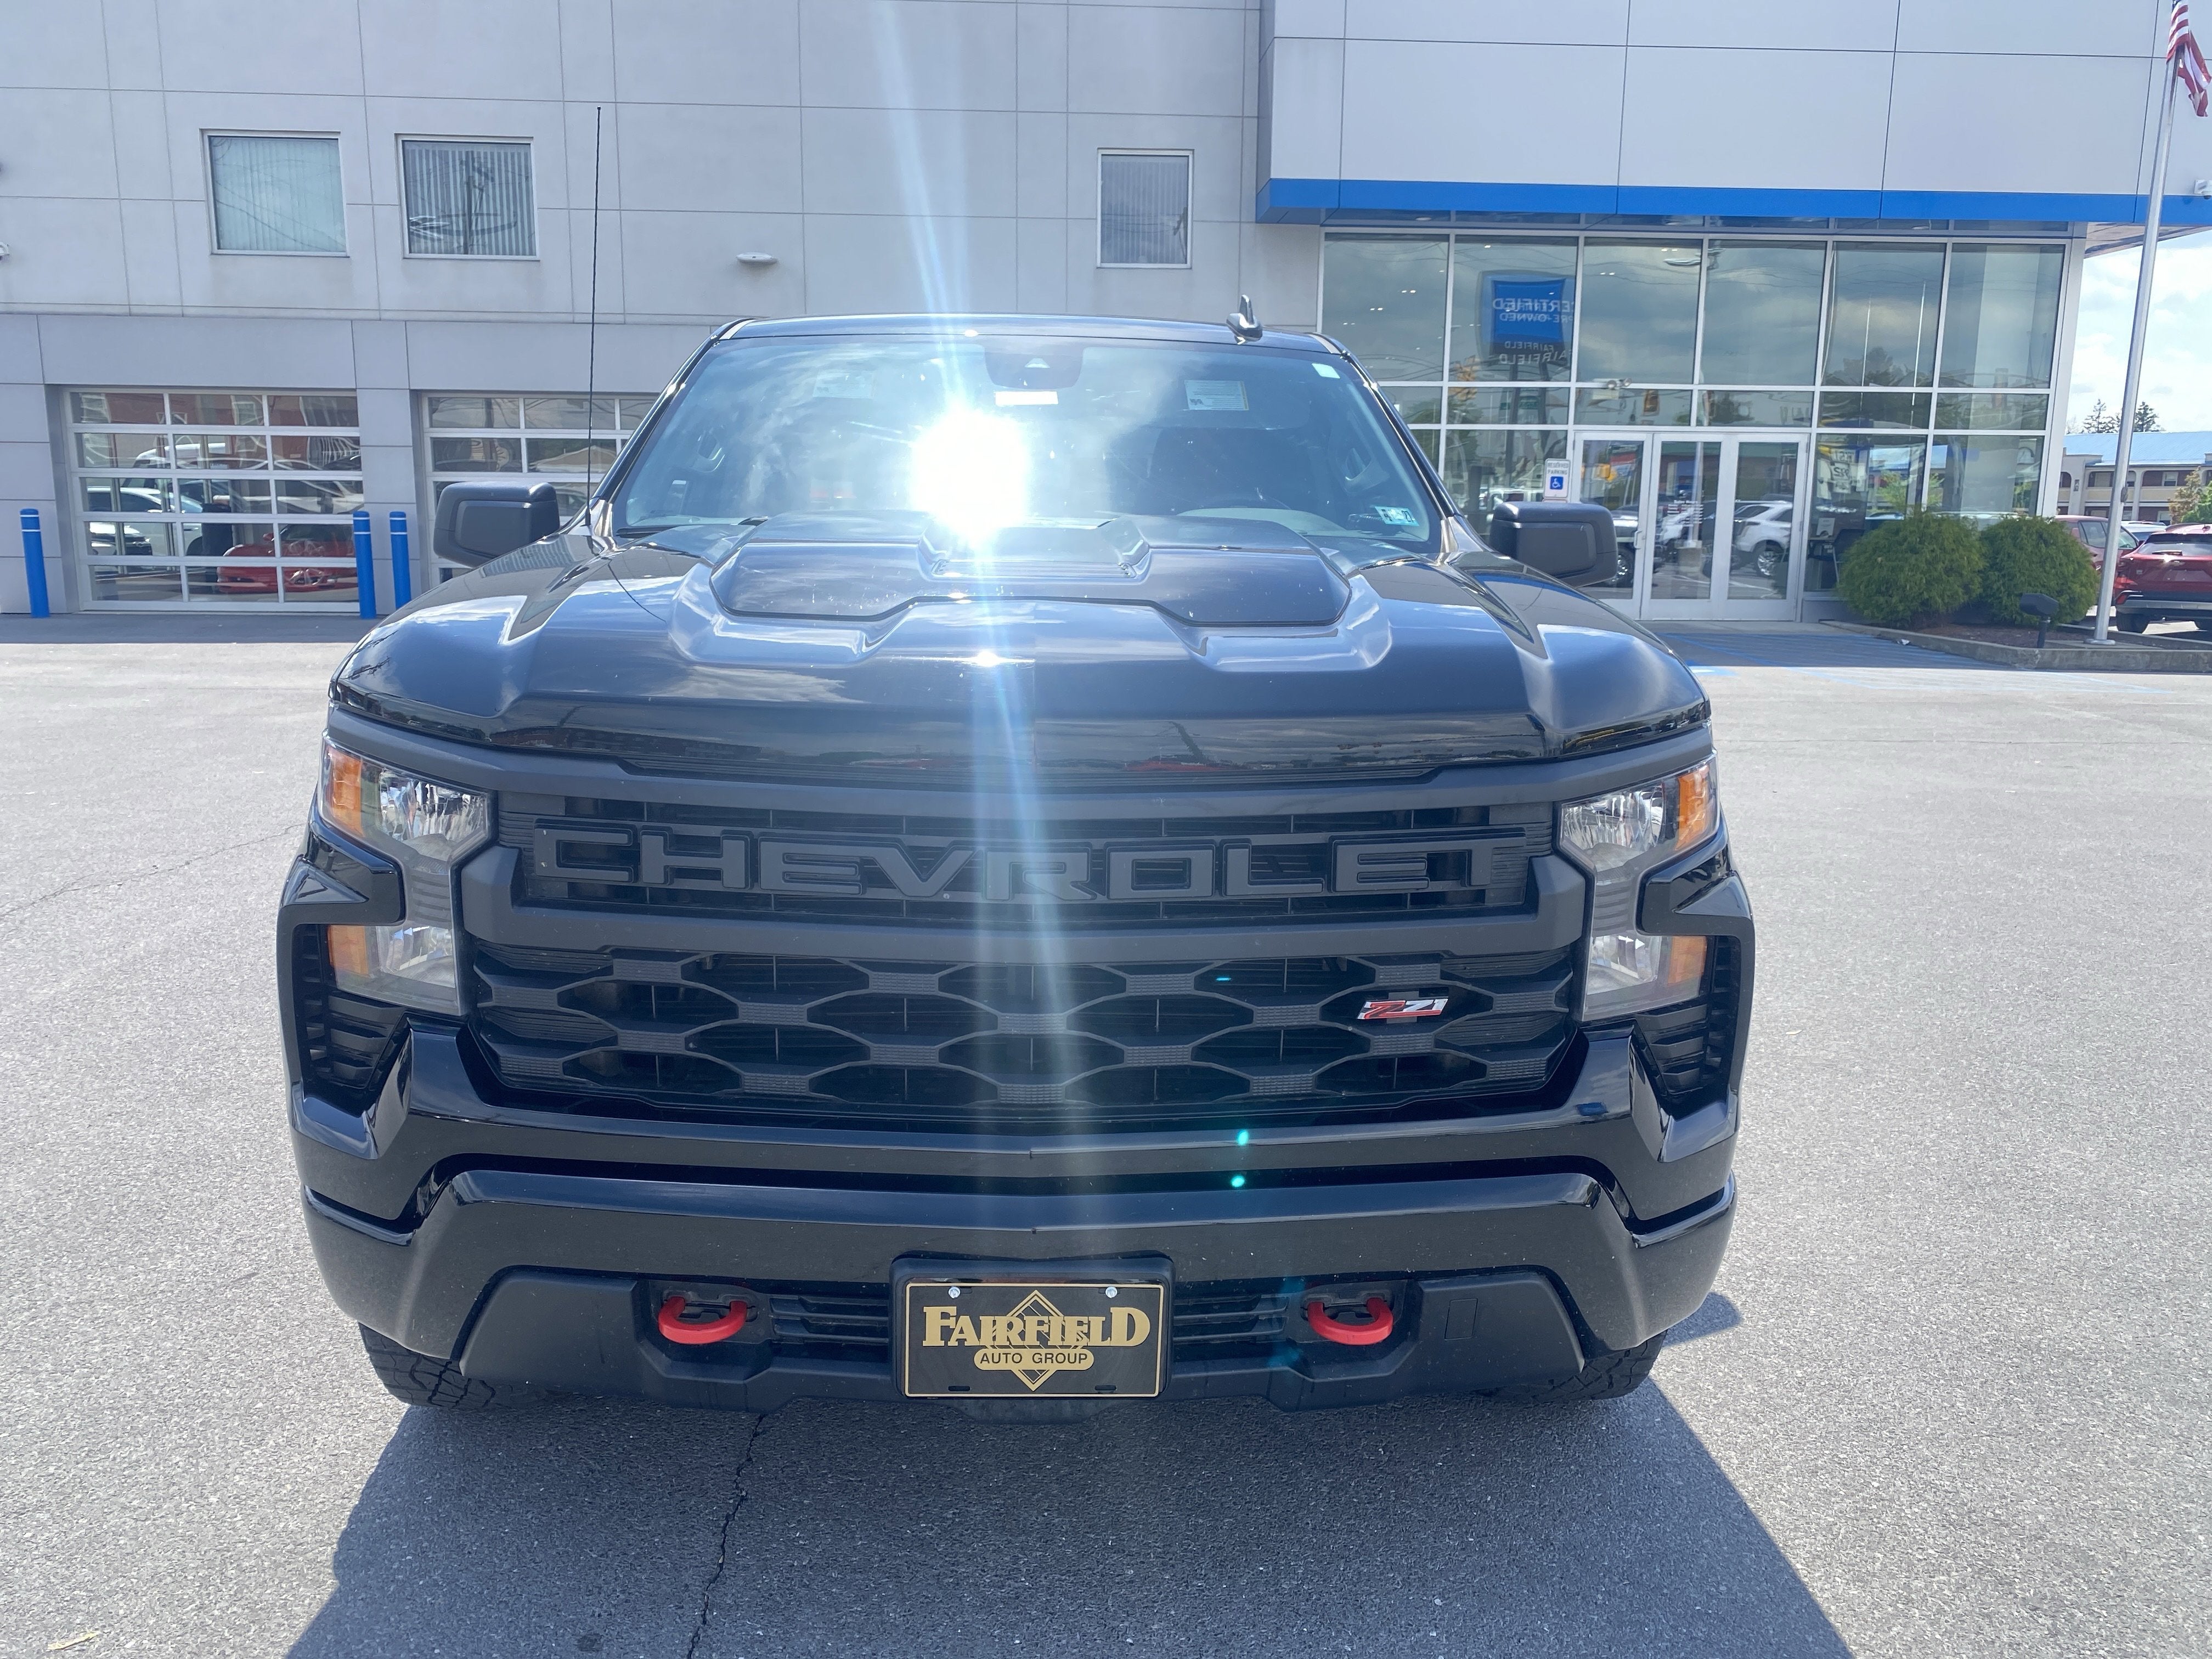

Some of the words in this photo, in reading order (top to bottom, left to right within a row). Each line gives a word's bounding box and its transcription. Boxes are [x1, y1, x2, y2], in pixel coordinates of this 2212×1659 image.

[534, 825, 1527, 901] CHEVROLET
[1357, 998, 1448, 1020] Z71
[923, 1306, 1151, 1347] FAIRFIELD
[979, 1352, 1023, 1364] AUTO
[1031, 1352, 1088, 1365] GROUP
